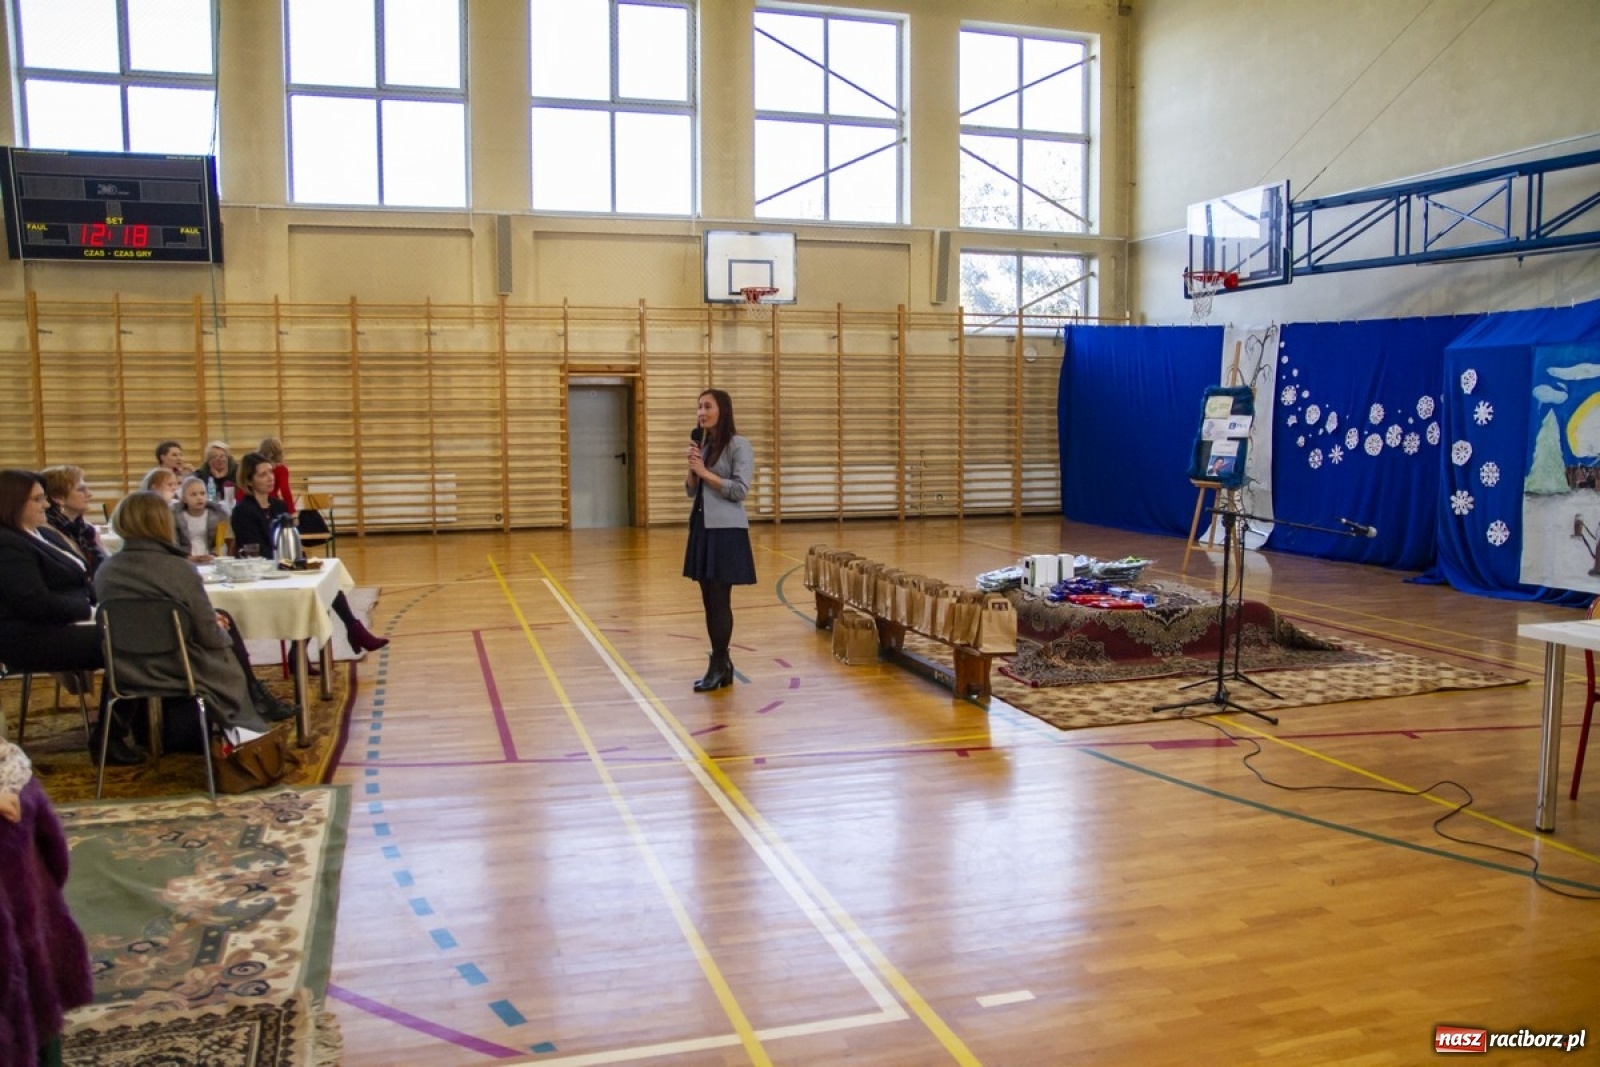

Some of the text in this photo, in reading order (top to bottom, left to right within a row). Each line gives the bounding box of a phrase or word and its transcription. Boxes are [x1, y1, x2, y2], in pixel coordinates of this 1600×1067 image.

[106, 216, 124, 225] SET
[27, 223, 48, 231] FAUL
[180, 227, 200, 235] FAUL
[83, 249, 105, 257] CZAS
[113, 250, 135, 258] CZAS
[135, 250, 153, 258] GRY
